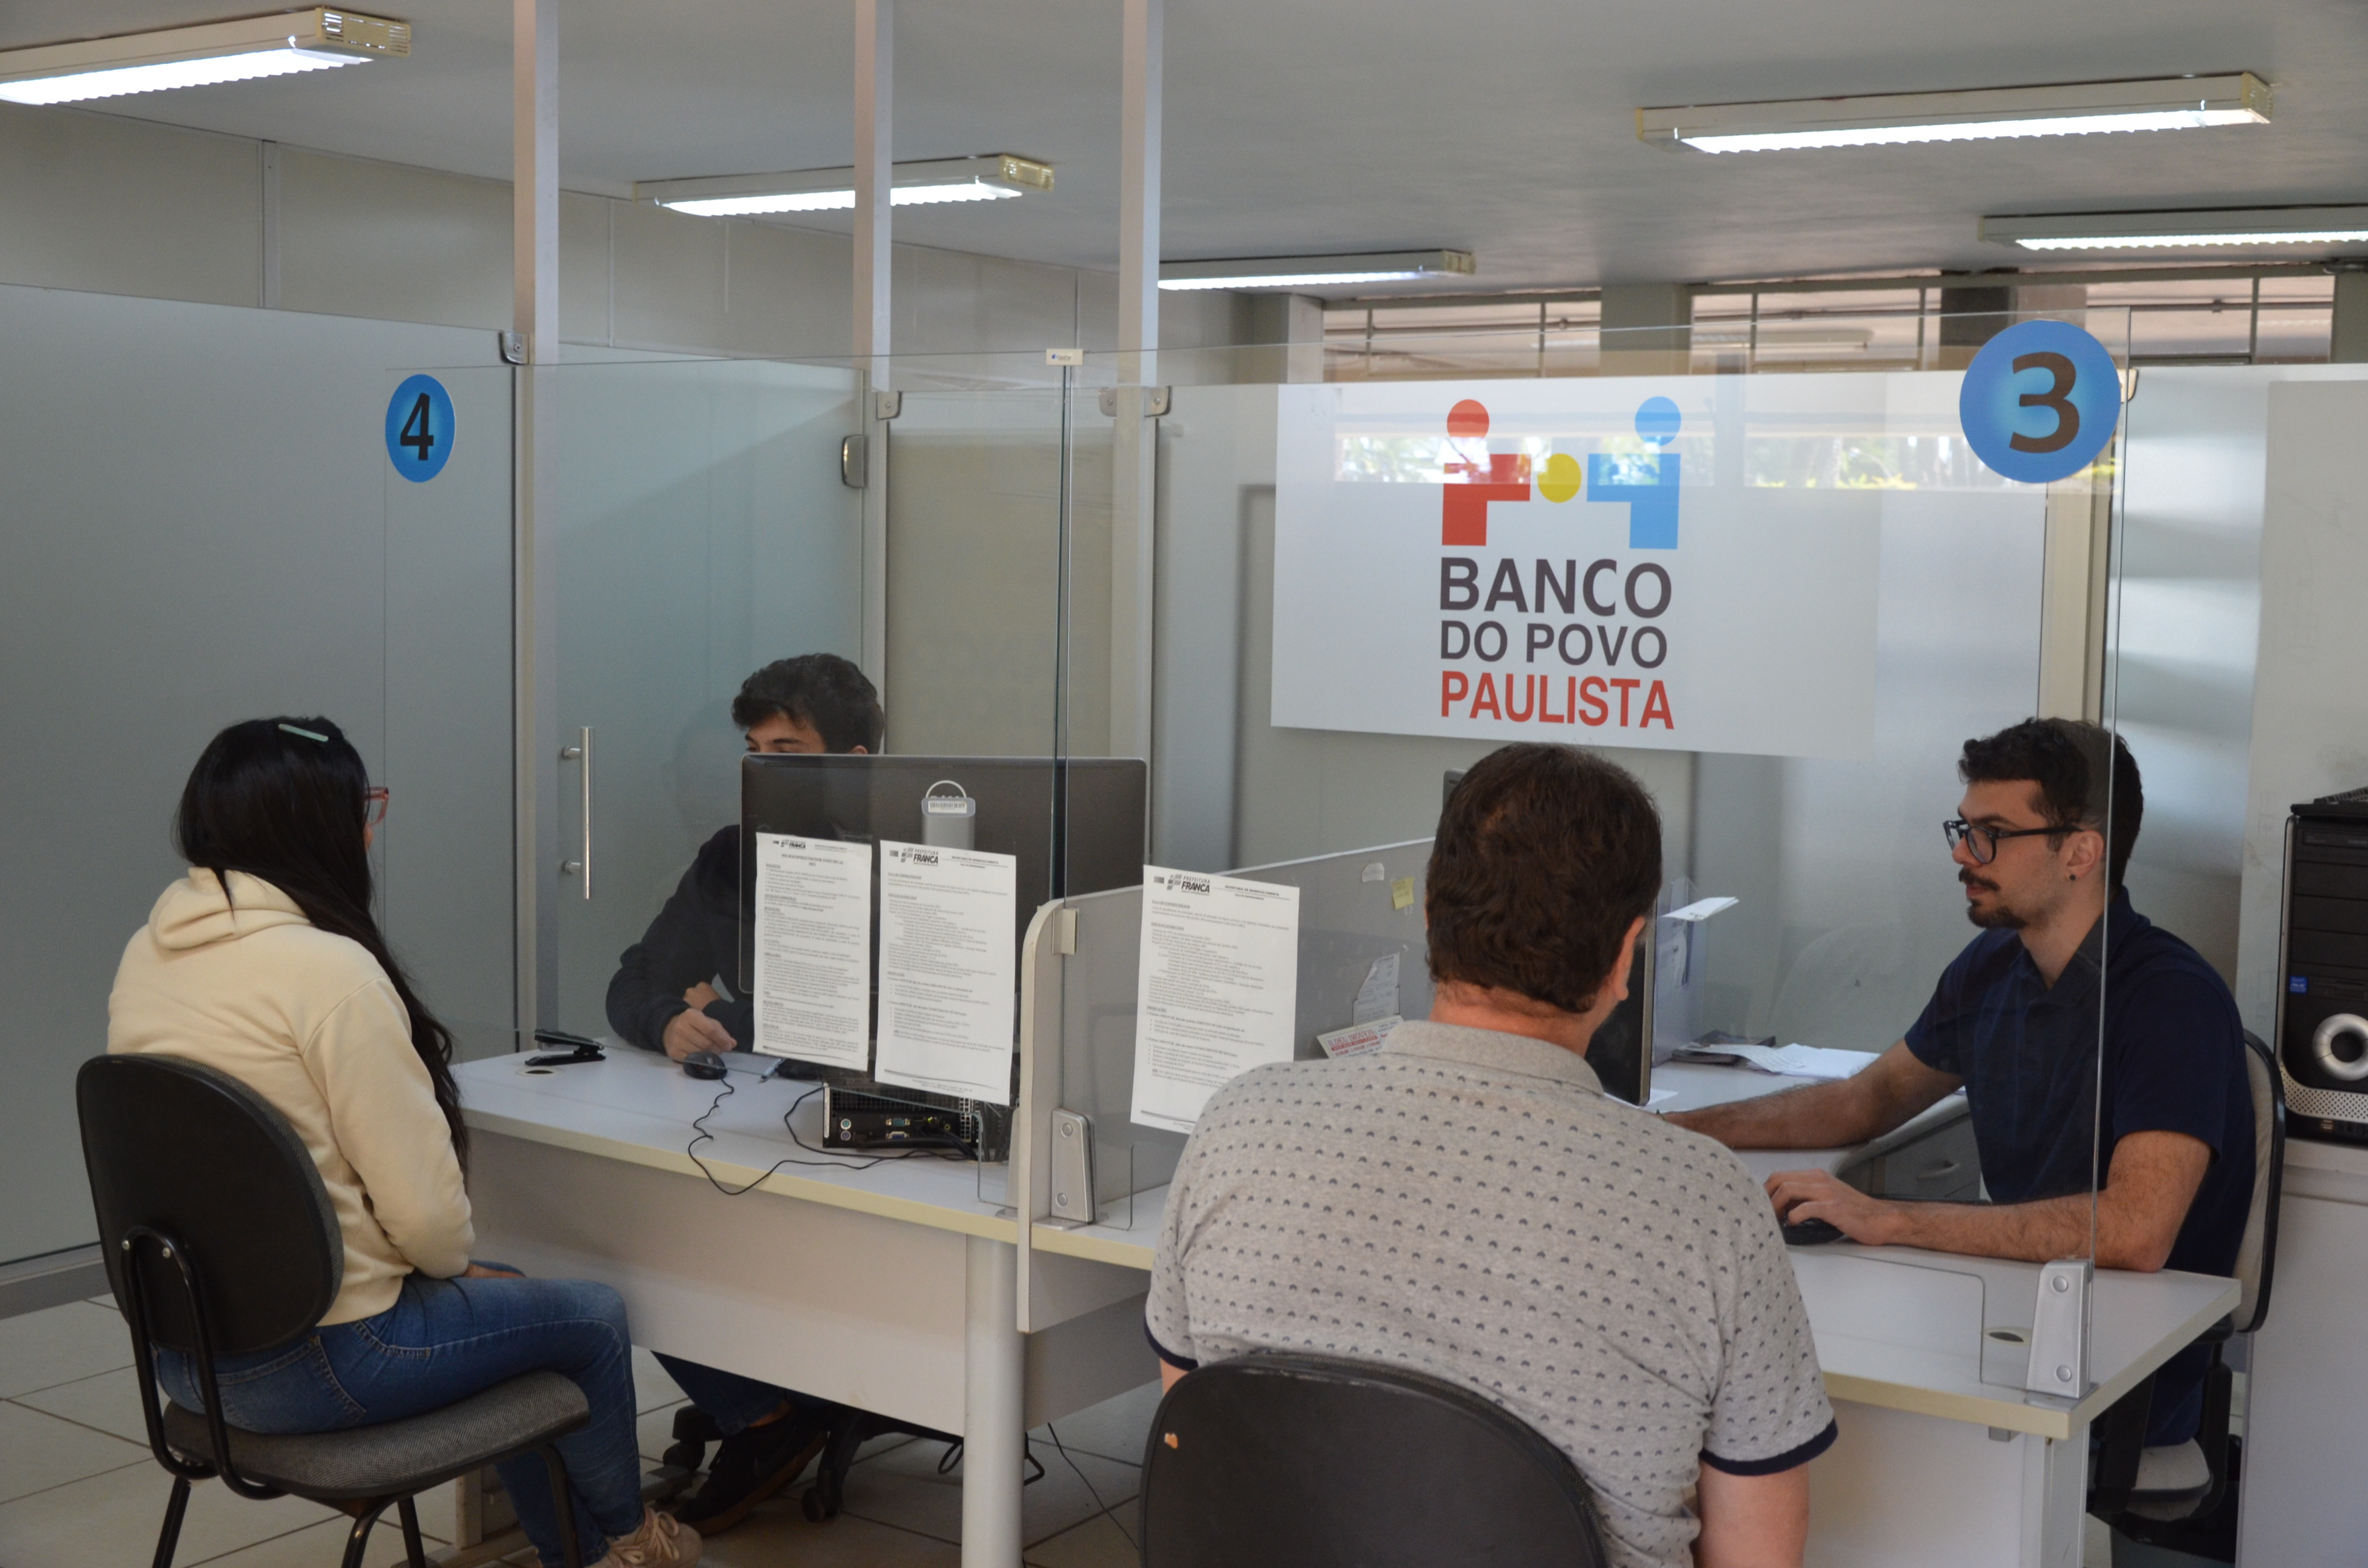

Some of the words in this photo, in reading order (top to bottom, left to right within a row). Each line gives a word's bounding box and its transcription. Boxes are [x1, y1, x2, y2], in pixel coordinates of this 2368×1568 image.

[400, 392, 434, 461] 4
[2009, 351, 2080, 453] 3
[1440, 557, 1672, 619] BANCO
[1441, 620, 1508, 662] DO
[1526, 623, 1667, 669] POVO
[1441, 670, 1674, 730] PAULISTA
[914, 853, 939, 865] FRANCA
[1183, 875, 1210, 884] PREFEITURA
[1181, 881, 1210, 894] FRANCA
